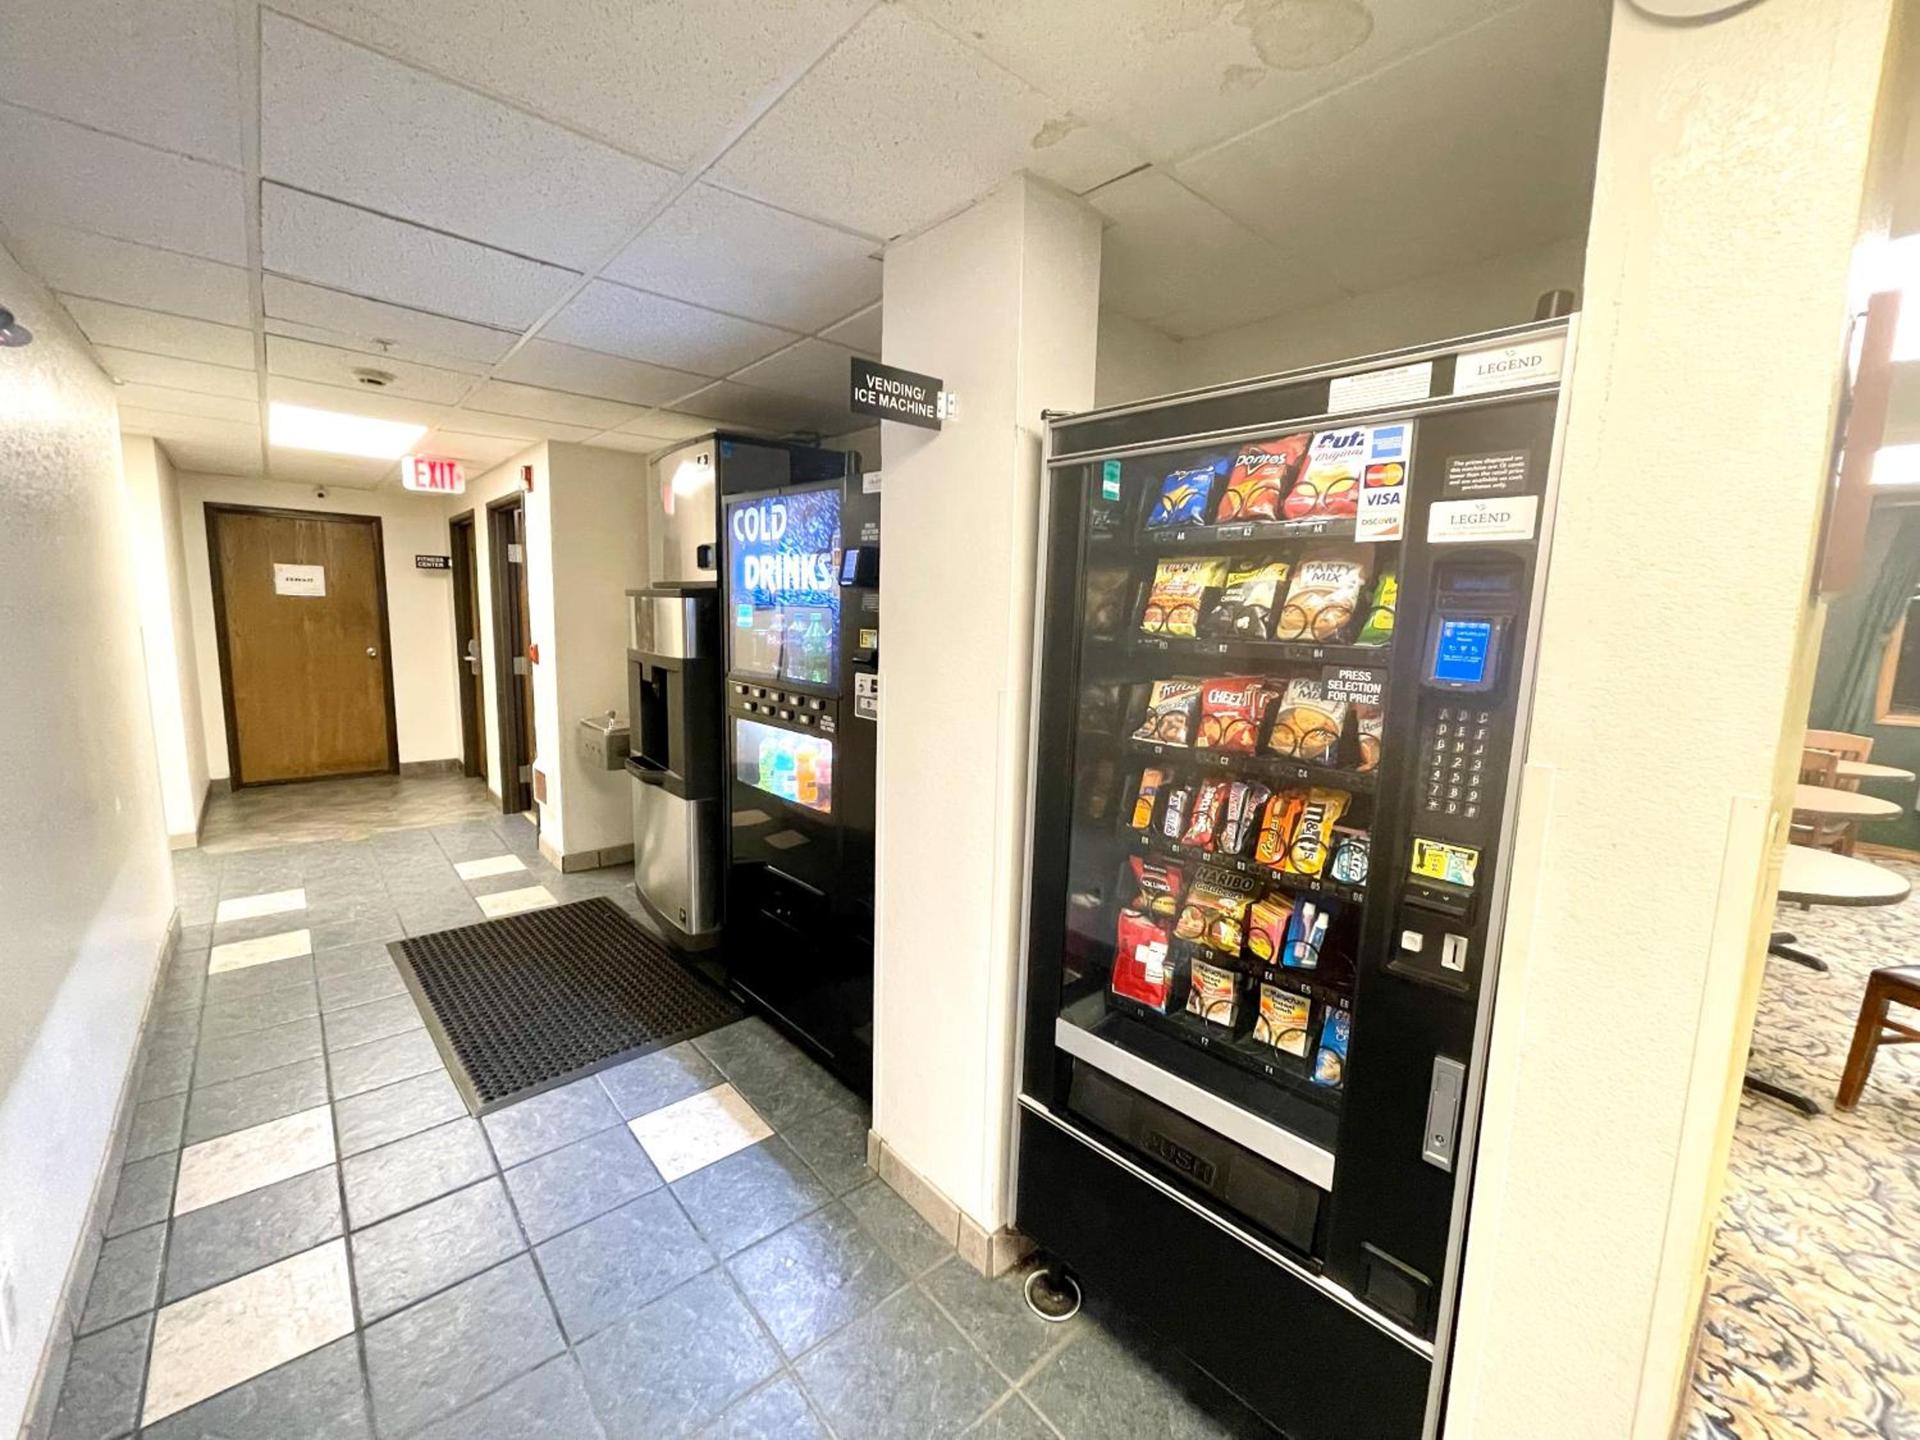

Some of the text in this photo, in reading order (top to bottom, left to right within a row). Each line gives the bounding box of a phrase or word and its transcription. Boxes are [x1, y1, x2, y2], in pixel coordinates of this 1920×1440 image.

[1477, 355, 1543, 376] LEGEND
[865, 374, 926, 401] VENDING/
[854, 387, 934, 418] ICE MACHINE
[1235, 453, 1287, 468] Doritos
[414, 459, 456, 490] EXIT
[1367, 492, 1401, 506] VISA
[733, 503, 788, 543] COLD
[1361, 516, 1398, 526] DISCOVER
[1450, 511, 1511, 526] LEGEND
[744, 552, 832, 594] DRINKS
[1306, 563, 1356, 575] PARTY
[1311, 572, 1342, 583] MIX
[1339, 669, 1372, 682] PRESS
[1327, 679, 1382, 694] SELECTION
[1327, 690, 1380, 705] FOR PRICE
[1456, 742, 1464, 752] H
[1453, 757, 1462, 768] 2
[1474, 759, 1482, 769] 3
[1297, 768, 1308, 778] C4
[1452, 772, 1460, 783] 5
[1472, 775, 1479, 786] 6
[1432, 785, 1478, 801] 7 8 9
[1195, 866, 1255, 892] HARIBO
[1195, 881, 1244, 901] Goldbears
[1264, 970, 1273, 981] E4
[1300, 983, 1311, 995] E5
[1201, 1036, 1210, 1046] F2
[1264, 1065, 1274, 1076] F4
